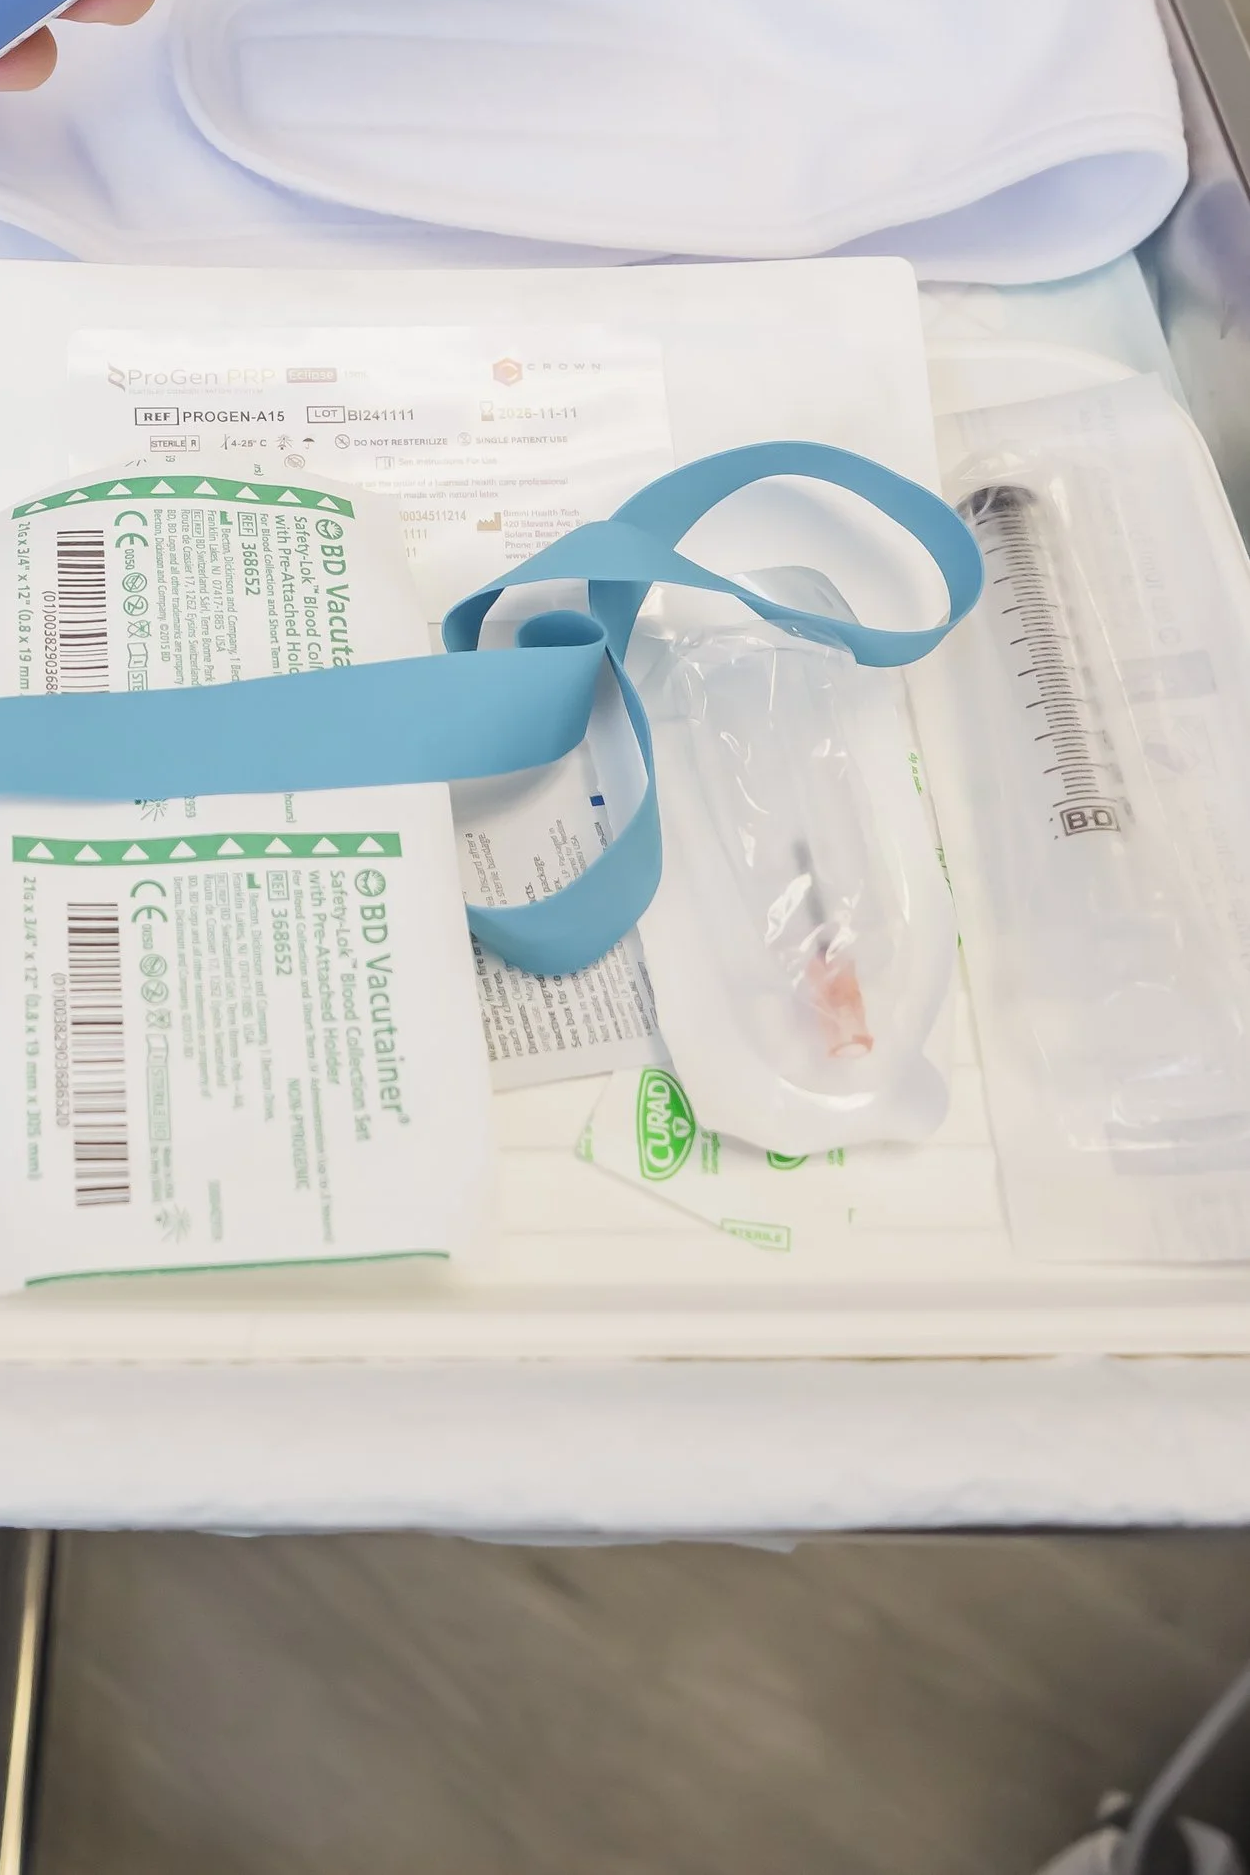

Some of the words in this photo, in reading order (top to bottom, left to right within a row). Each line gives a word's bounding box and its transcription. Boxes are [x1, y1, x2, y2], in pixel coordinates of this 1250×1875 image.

[128, 368, 219, 387] ProGen
[526, 362, 602, 371] CROWN
[143, 411, 171, 422] REF
[183, 410, 285, 423] PROGEN-A15
[314, 408, 338, 418] LOT
[347, 408, 416, 422] BI241111
[151, 439, 186, 448] STERILE
[354, 438, 367, 447] DO
[369, 437, 389, 446] NOT
[391, 437, 448, 446] RESTERILIZE
[475, 435, 509, 445] SINGLE
[510, 435, 548, 444] PATIENT
[549, 434, 568, 444] USE
[153, 509, 164, 536] Becton,
[166, 509, 176, 521] BD,
[181, 509, 191, 533] Route
[207, 509, 219, 541] Franklin
[241, 514, 254, 533] REF
[260, 513, 270, 525] For
[168, 523, 177, 533] BD
[182, 535, 192, 544] de
[275, 515, 290, 544] with
[166, 535, 177, 551] Logo
[196, 539, 207, 549] BD
[220, 528, 231, 555] Becton,
[262, 528, 272, 552] Blood
[124, 549, 135, 570] 0050
[154, 537, 165, 569] Dickinson
[169, 553, 179, 565] and
[183, 546, 193, 573] Crassier
[208, 543, 220, 563] Lakes,
[321, 545, 346, 575] BD
[157, 569, 168, 583] and
[170, 567, 181, 575] all
[197, 551, 210, 594] Switzerland
[211, 565, 220, 575] NJ
[223, 556, 235, 594] Dickinson
[241, 542, 260, 596] 368652
[263, 554, 276, 596] Collection
[171, 576, 182, 595] other
[184, 576, 194, 587] 17,
[278, 548, 300, 637] Pre-Attached
[186, 591, 196, 609] 1262
[212, 579, 224, 630] 07417-1885
[226, 597, 237, 612] and
[267, 599, 278, 616] and
[18, 609, 34, 633] (0.8
[172, 597, 184, 639] trademarks
[185, 613, 198, 638] Eysins
[200, 616, 212, 635] Terre
[303, 596, 321, 637] Blood
[226, 615, 238, 655] Company,
[269, 619, 280, 644] Short
[20, 647, 32, 661] 19
[174, 641, 183, 652] are
[202, 638, 213, 662] Bonne
[215, 635, 226, 652] USA
[161, 651, 170, 662] BD
[188, 639, 201, 686] Switzerland
[270, 646, 281, 669] Term
[20, 666, 30, 689] mm
[170, 654, 184, 685] property
[205, 665, 216, 682] Park
[467, 840, 480, 859] after
[271, 873, 285, 896] REF
[309, 869, 326, 907] with
[474, 861, 490, 893] Discard
[23, 904, 34, 912] x
[293, 889, 305, 919] Blood
[360, 902, 388, 944] BD
[270, 908, 293, 977] 368652
[24, 952, 35, 960] x
[312, 912, 335, 1022] Pre-Attached
[477, 958, 487, 976] fire
[340, 973, 360, 1021] Blood
[482, 978, 494, 1001] from
[557, 989, 567, 1005] for
[490, 1004, 502, 1031] away
[504, 1015, 514, 1025] of
[564, 1007, 575, 1026] box
[509, 1028, 523, 1057] reach
[323, 1027, 341, 1084] Holder
[346, 1026, 366, 1111] Collection
[355, 1114, 371, 1142] Set
[645, 1079, 674, 1168] CURAD
